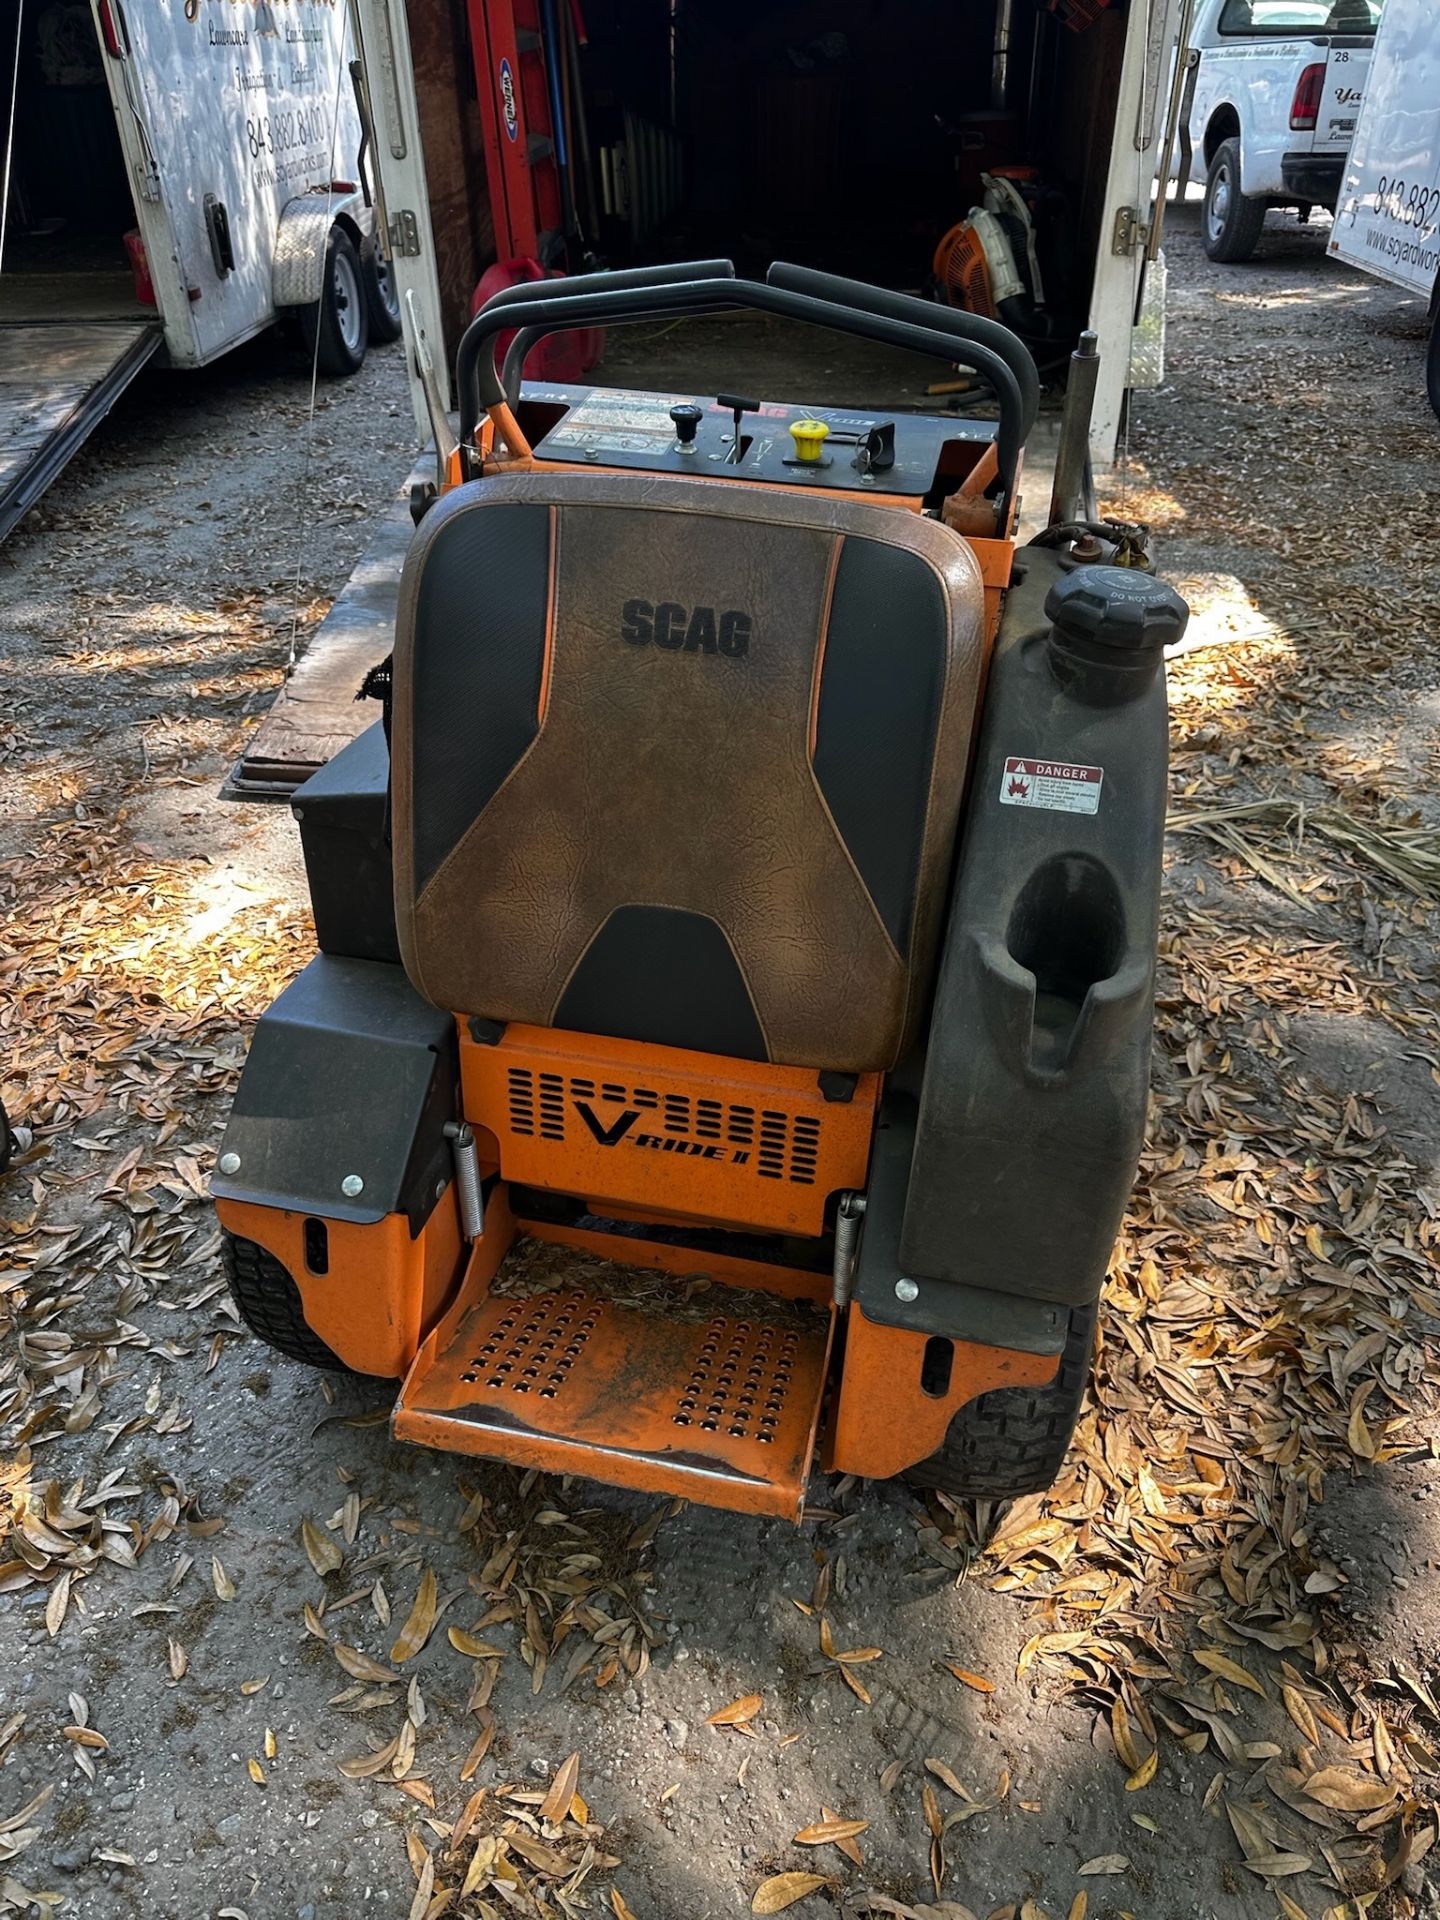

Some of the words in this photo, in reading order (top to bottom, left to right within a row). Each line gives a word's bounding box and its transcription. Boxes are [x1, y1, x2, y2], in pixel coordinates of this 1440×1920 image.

[1334, 52, 1349, 62] 28
[503, 77, 514, 124] WERNER
[1374, 175, 1440, 234] 843.882.
[621, 598, 752, 657] SCAG
[1036, 764, 1088, 780] DANGER
